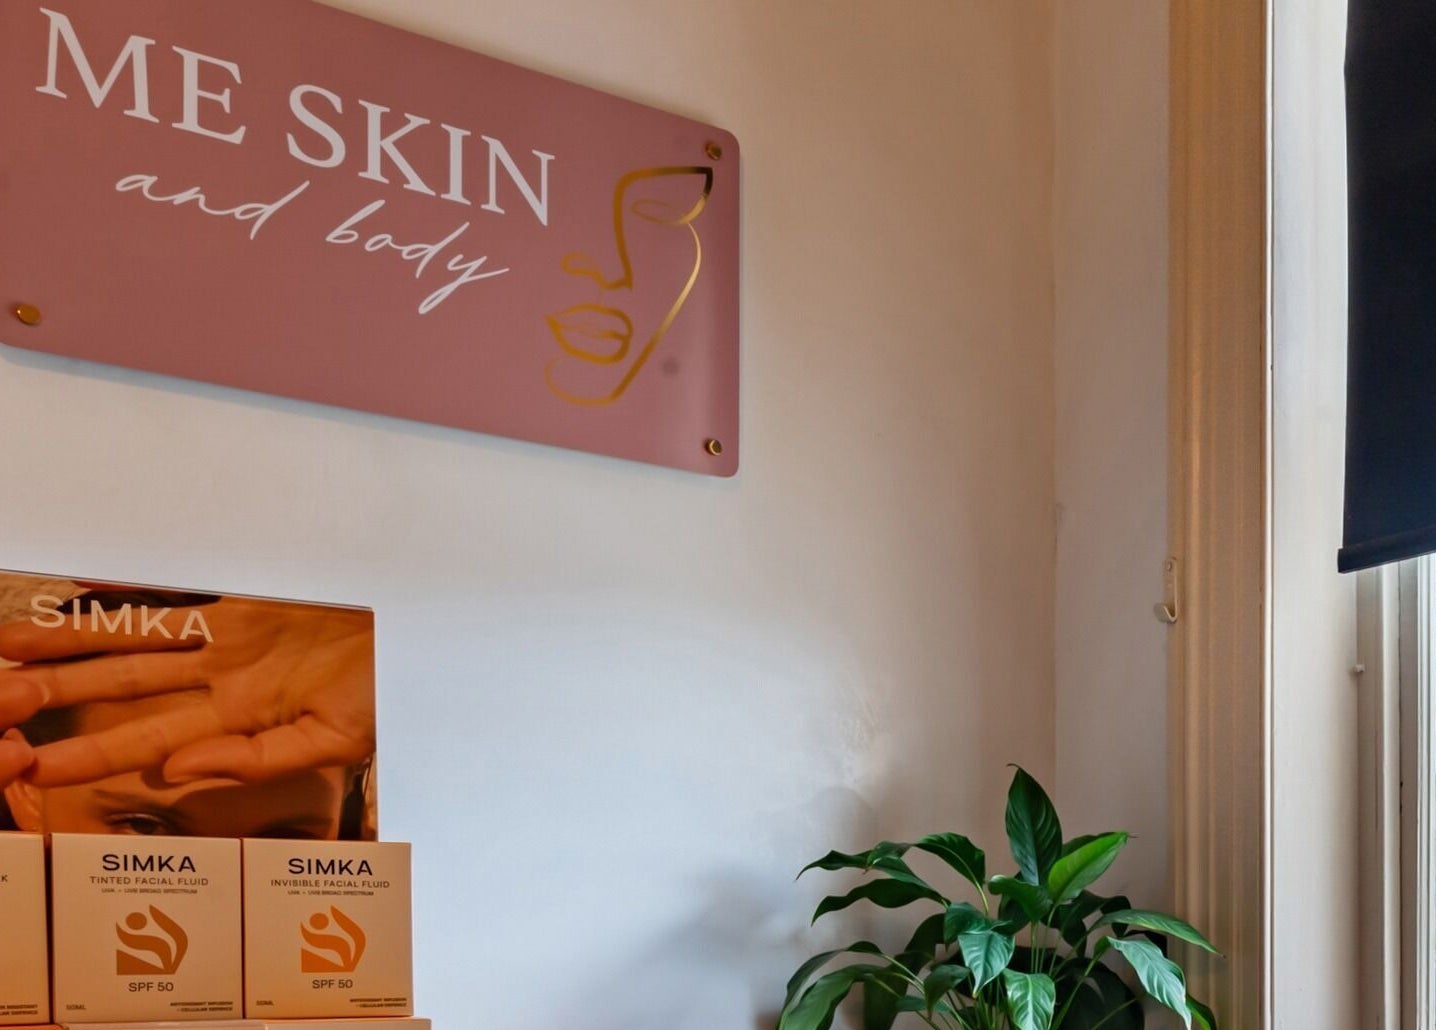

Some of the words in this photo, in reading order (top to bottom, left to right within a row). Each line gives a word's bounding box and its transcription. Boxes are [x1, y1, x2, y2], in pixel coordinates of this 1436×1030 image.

[35, 7, 247, 145] ME
[286, 84, 556, 227] SKIN
[115, 171, 311, 240] and
[325, 200, 509, 316] body
[30, 594, 214, 643] SIMKA
[102, 854, 197, 873] SIMKA
[288, 858, 373, 876] SIMKA
[89, 876, 131, 885] TINTED
[135, 877, 174, 886] FACIAL
[177, 877, 209, 887] FLUID
[270, 879, 320, 888] INVISIBLE
[323, 880, 358, 888] FACIAL
[361, 880, 390, 889] FLUID
[128, 982, 154, 992] SPF
[157, 981, 175, 992] 50
[312, 979, 335, 989] SPF
[338, 979, 354, 989] 50
